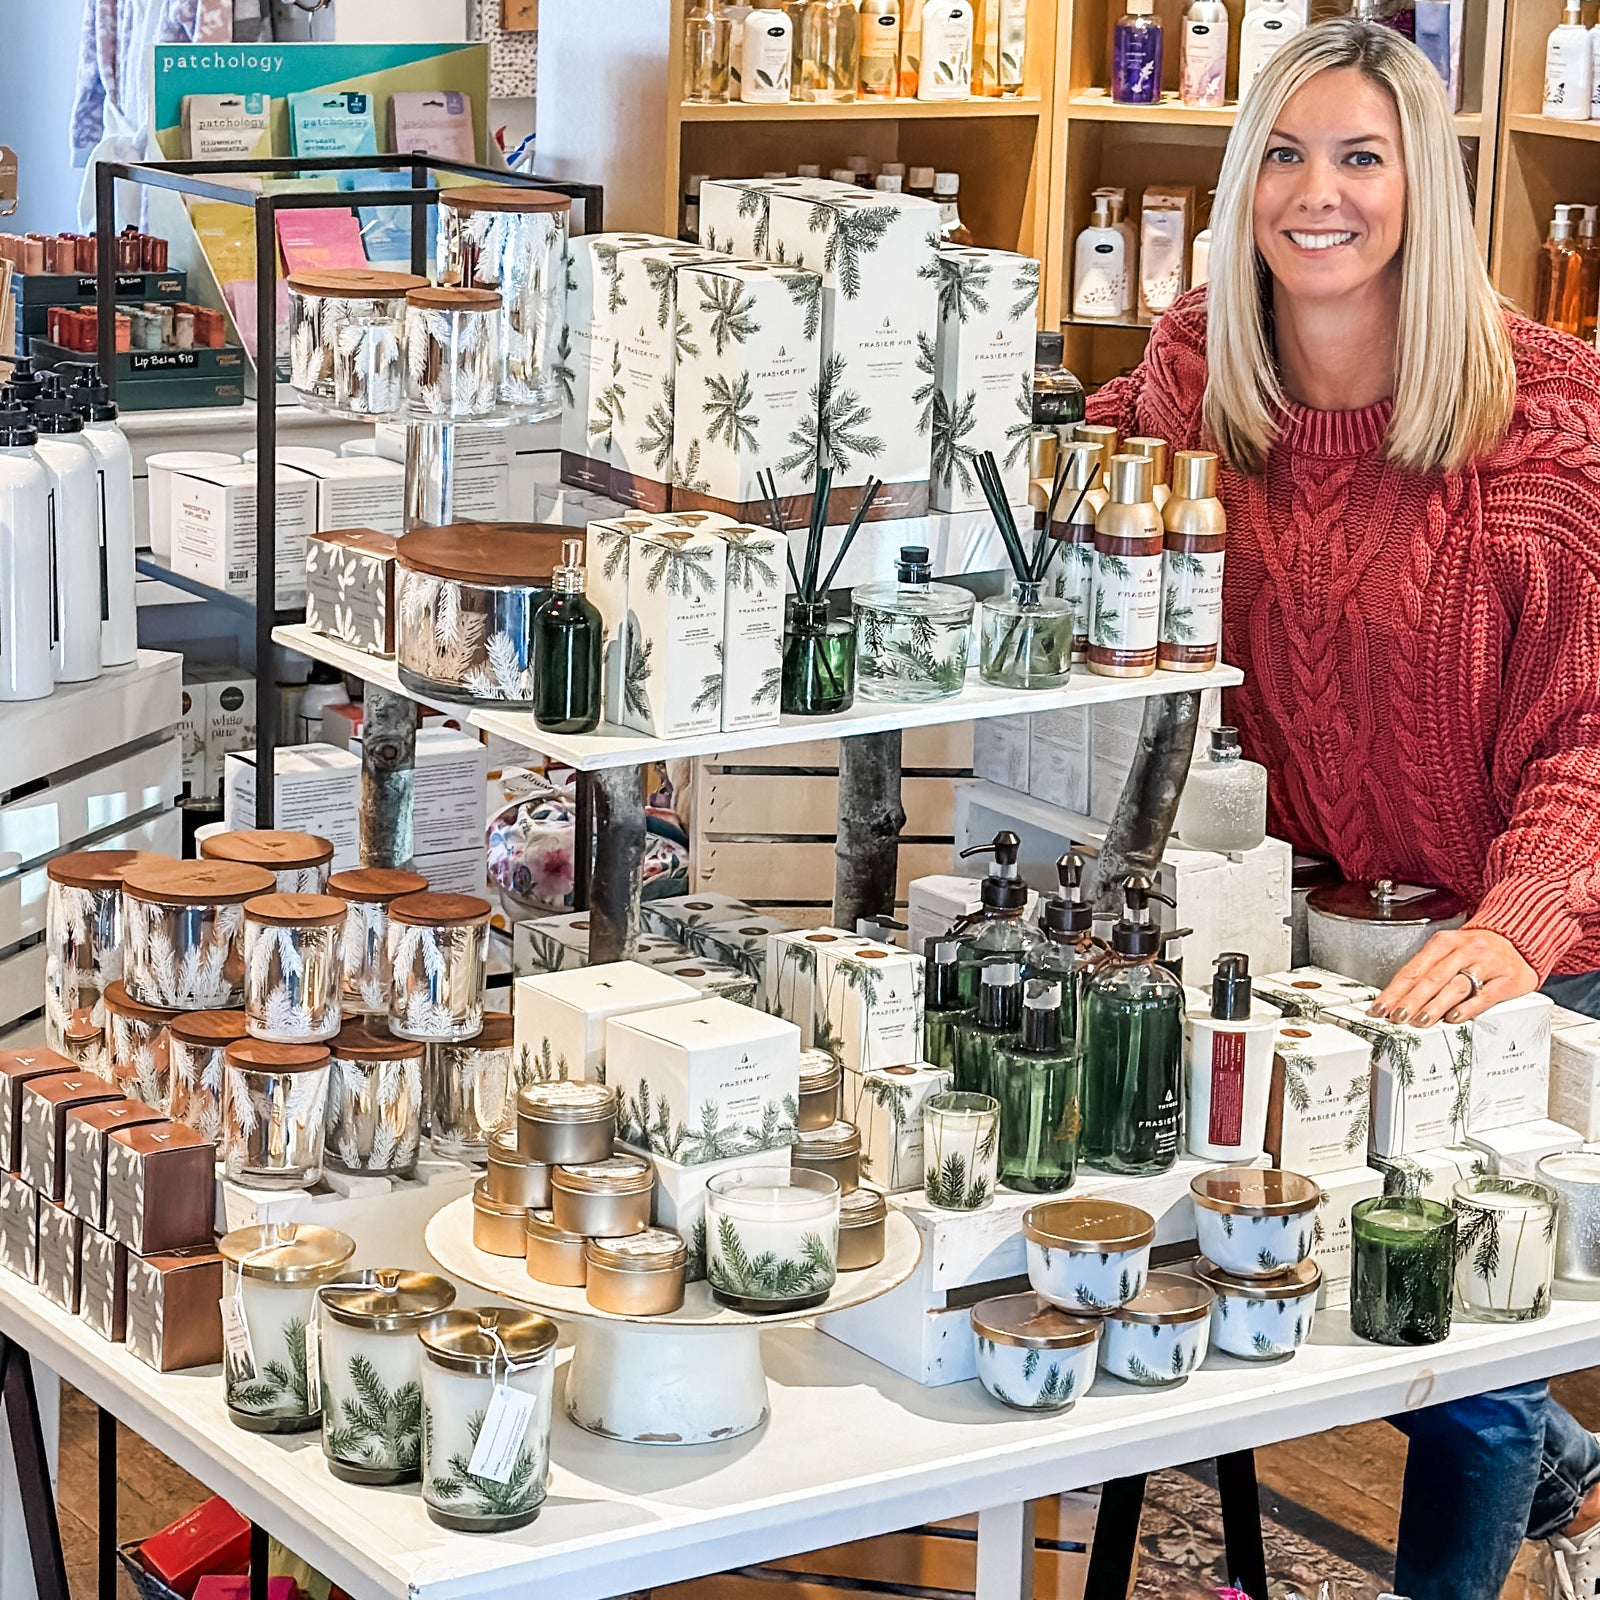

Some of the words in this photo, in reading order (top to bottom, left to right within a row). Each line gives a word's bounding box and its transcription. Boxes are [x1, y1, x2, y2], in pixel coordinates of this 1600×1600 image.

[163, 51, 283, 72] patchology
[199, 117, 265, 130] patchology
[134, 355, 150, 369] Lip
[150, 355, 176, 365] Balm
[178, 353, 194, 364] $10
[1138, 1115, 1177, 1128] FRASIER
[1300, 1112, 1337, 1123] FRASIER
[1314, 1243, 1351, 1256] FRASIER
